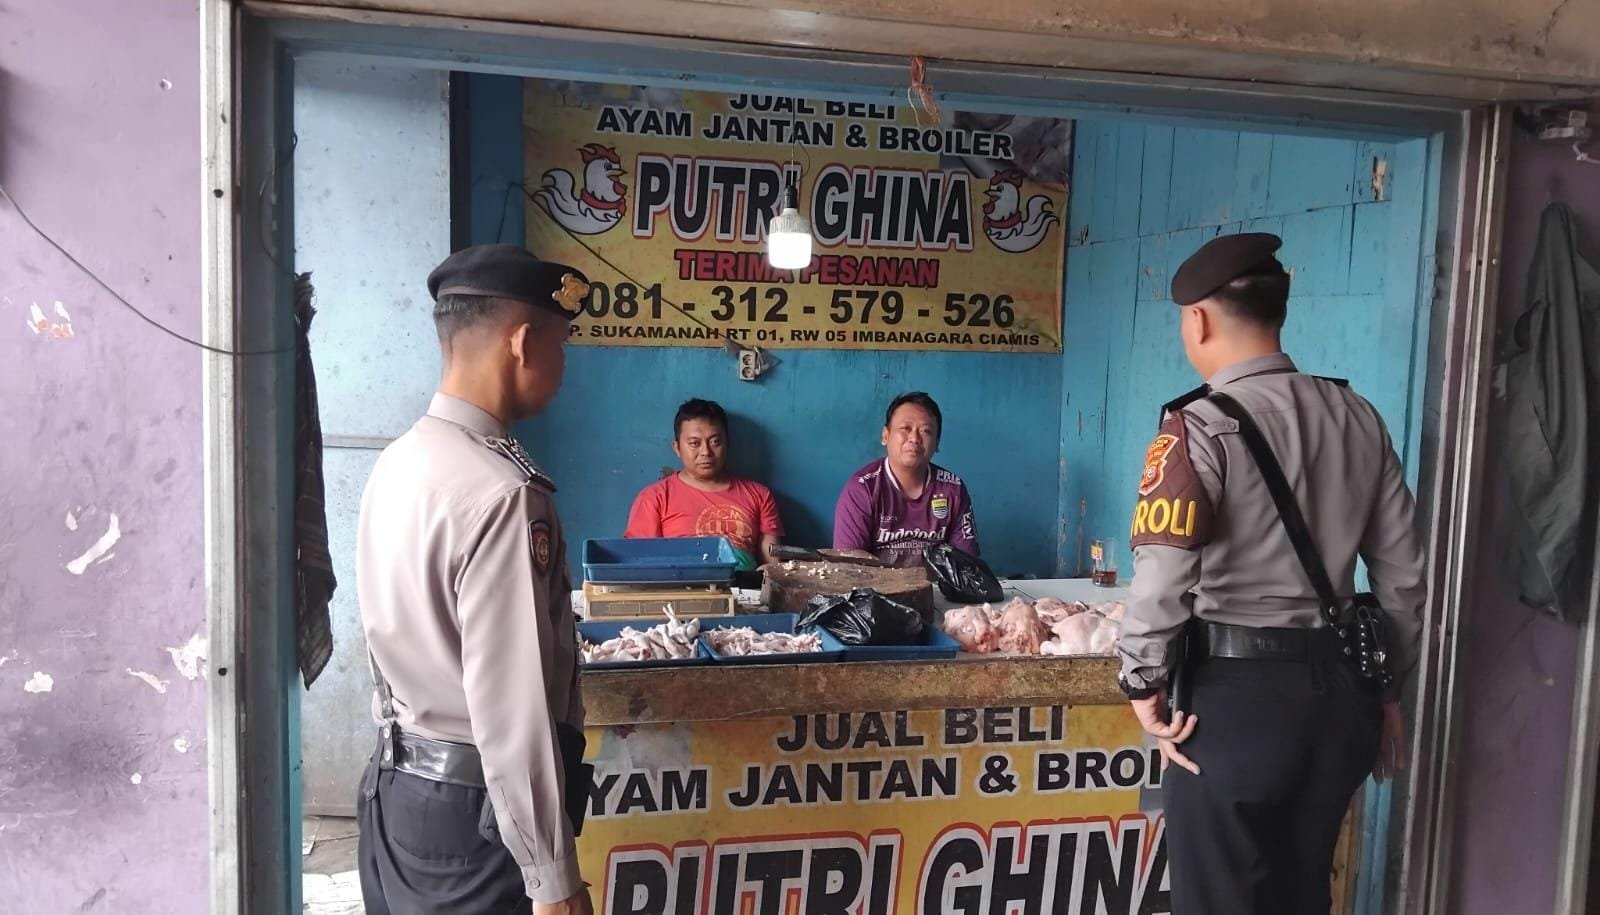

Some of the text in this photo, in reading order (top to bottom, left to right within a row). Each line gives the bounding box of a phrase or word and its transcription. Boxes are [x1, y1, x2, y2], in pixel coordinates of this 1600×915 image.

[730, 93, 895, 120] JUAL BELI
[596, 107, 1014, 158] AYAM JANTAN & BROILER
[633, 153, 974, 251] PUTR GHINA
[674, 249, 939, 288] TERIMA PESANAN
[587, 281, 662, 319] 081
[710, 285, 789, 323] 312
[829, 289, 904, 325] 579
[943, 292, 1015, 328] 526
[590, 325, 720, 340] SUKAMANAH
[726, 328, 750, 341] RT
[756, 328, 784, 343] 01,
[790, 330, 819, 342] RW
[825, 330, 847, 342] 05
[852, 331, 974, 345] IMBANAGARA
[979, 333, 1040, 346] CIAMIS
[877, 526, 947, 543] Indofood
[1130, 498, 1197, 537] ROLI
[777, 704, 1063, 752] JUAL BELI
[728, 757, 957, 807] JANTAN
[979, 754, 1017, 794] &
